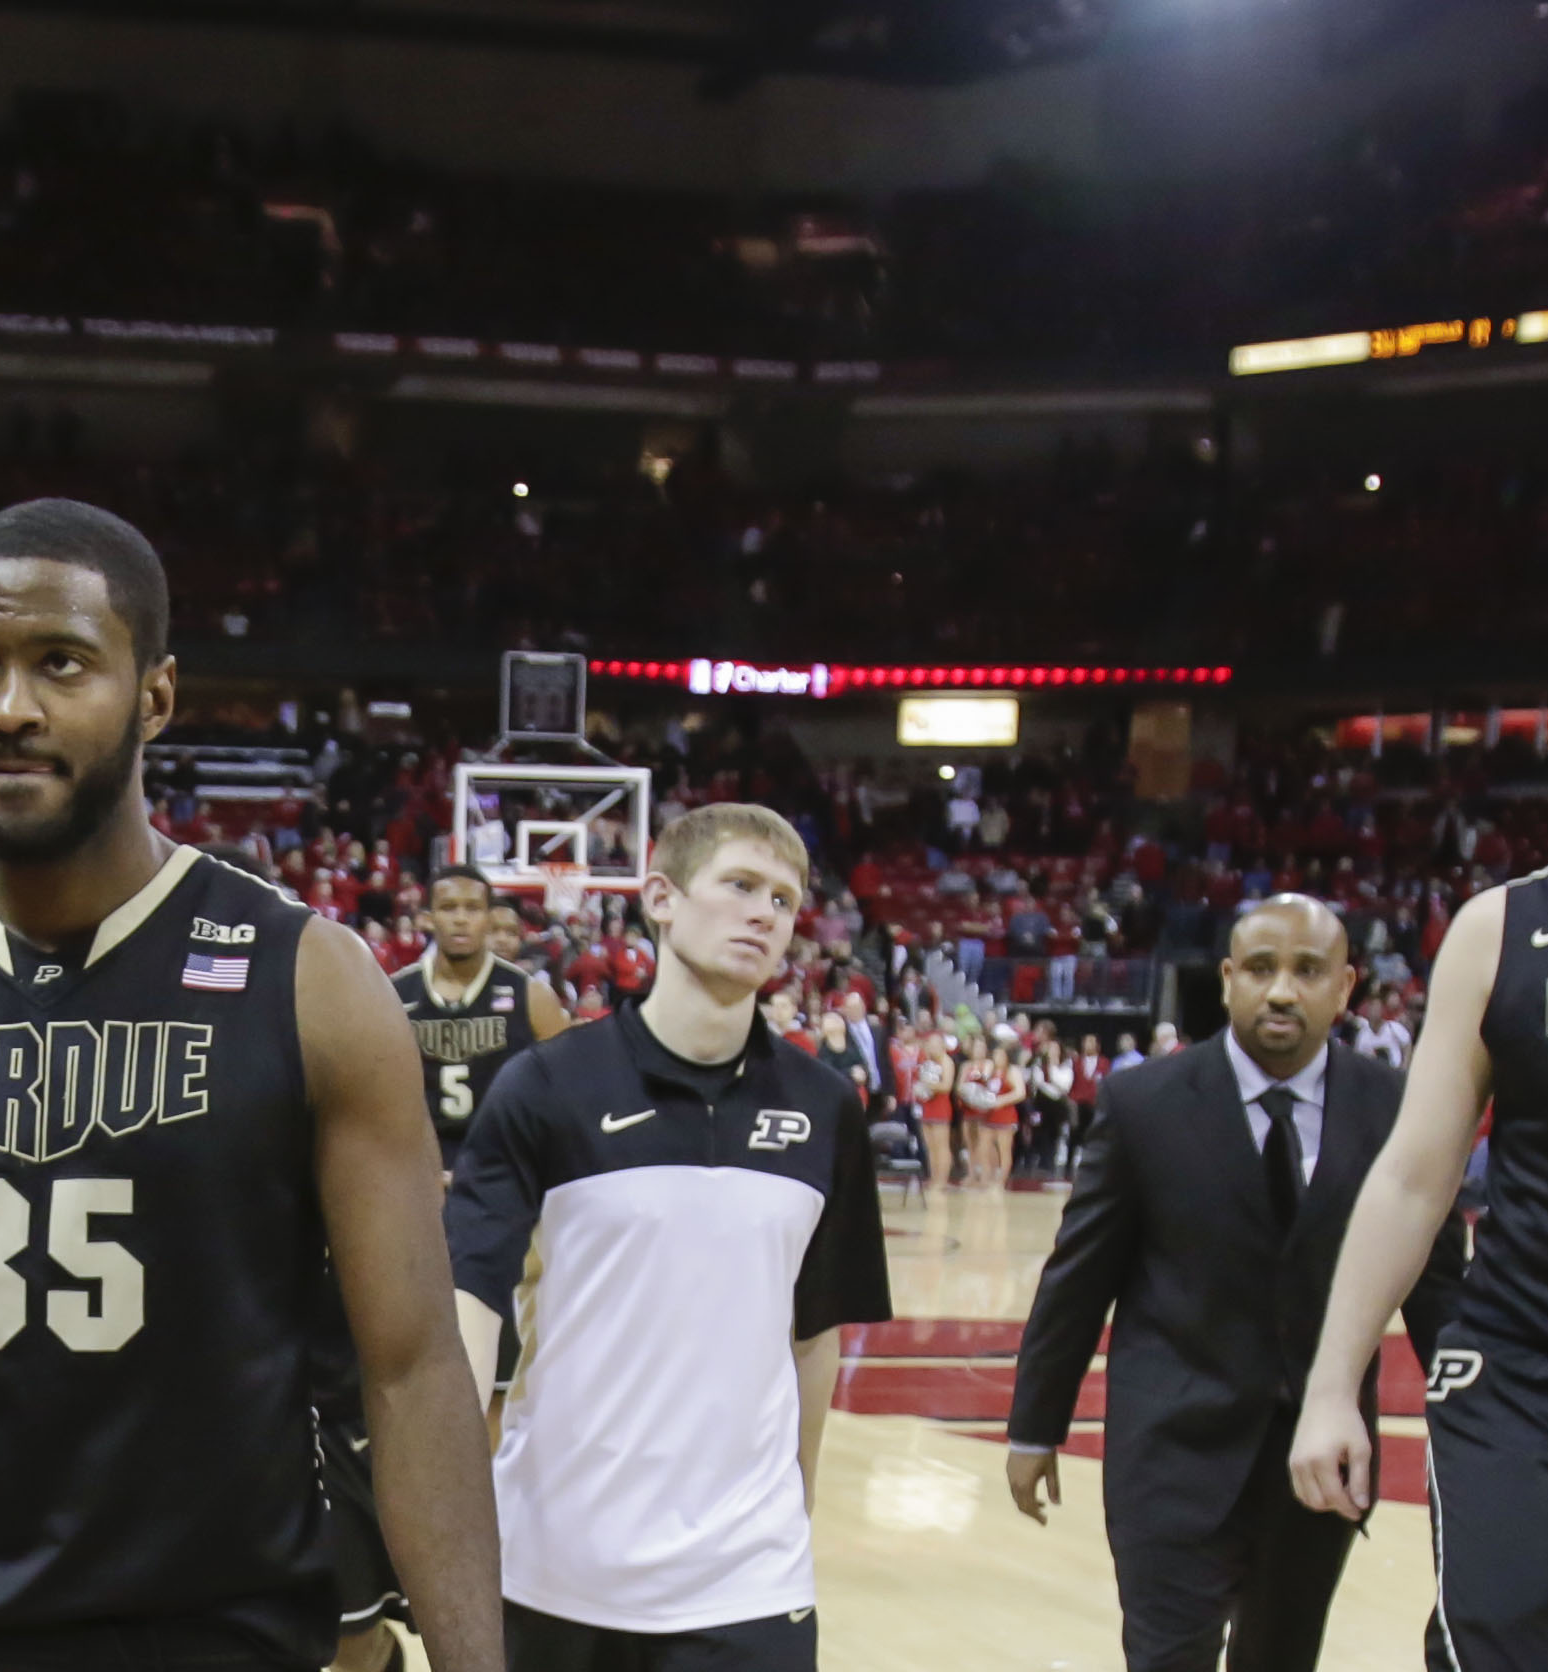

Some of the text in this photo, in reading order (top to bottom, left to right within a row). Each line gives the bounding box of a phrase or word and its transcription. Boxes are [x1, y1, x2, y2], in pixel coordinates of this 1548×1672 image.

[439, 1064, 474, 1119] 5
[748, 1108, 811, 1151] P
[1426, 1348, 1483, 1402] P
